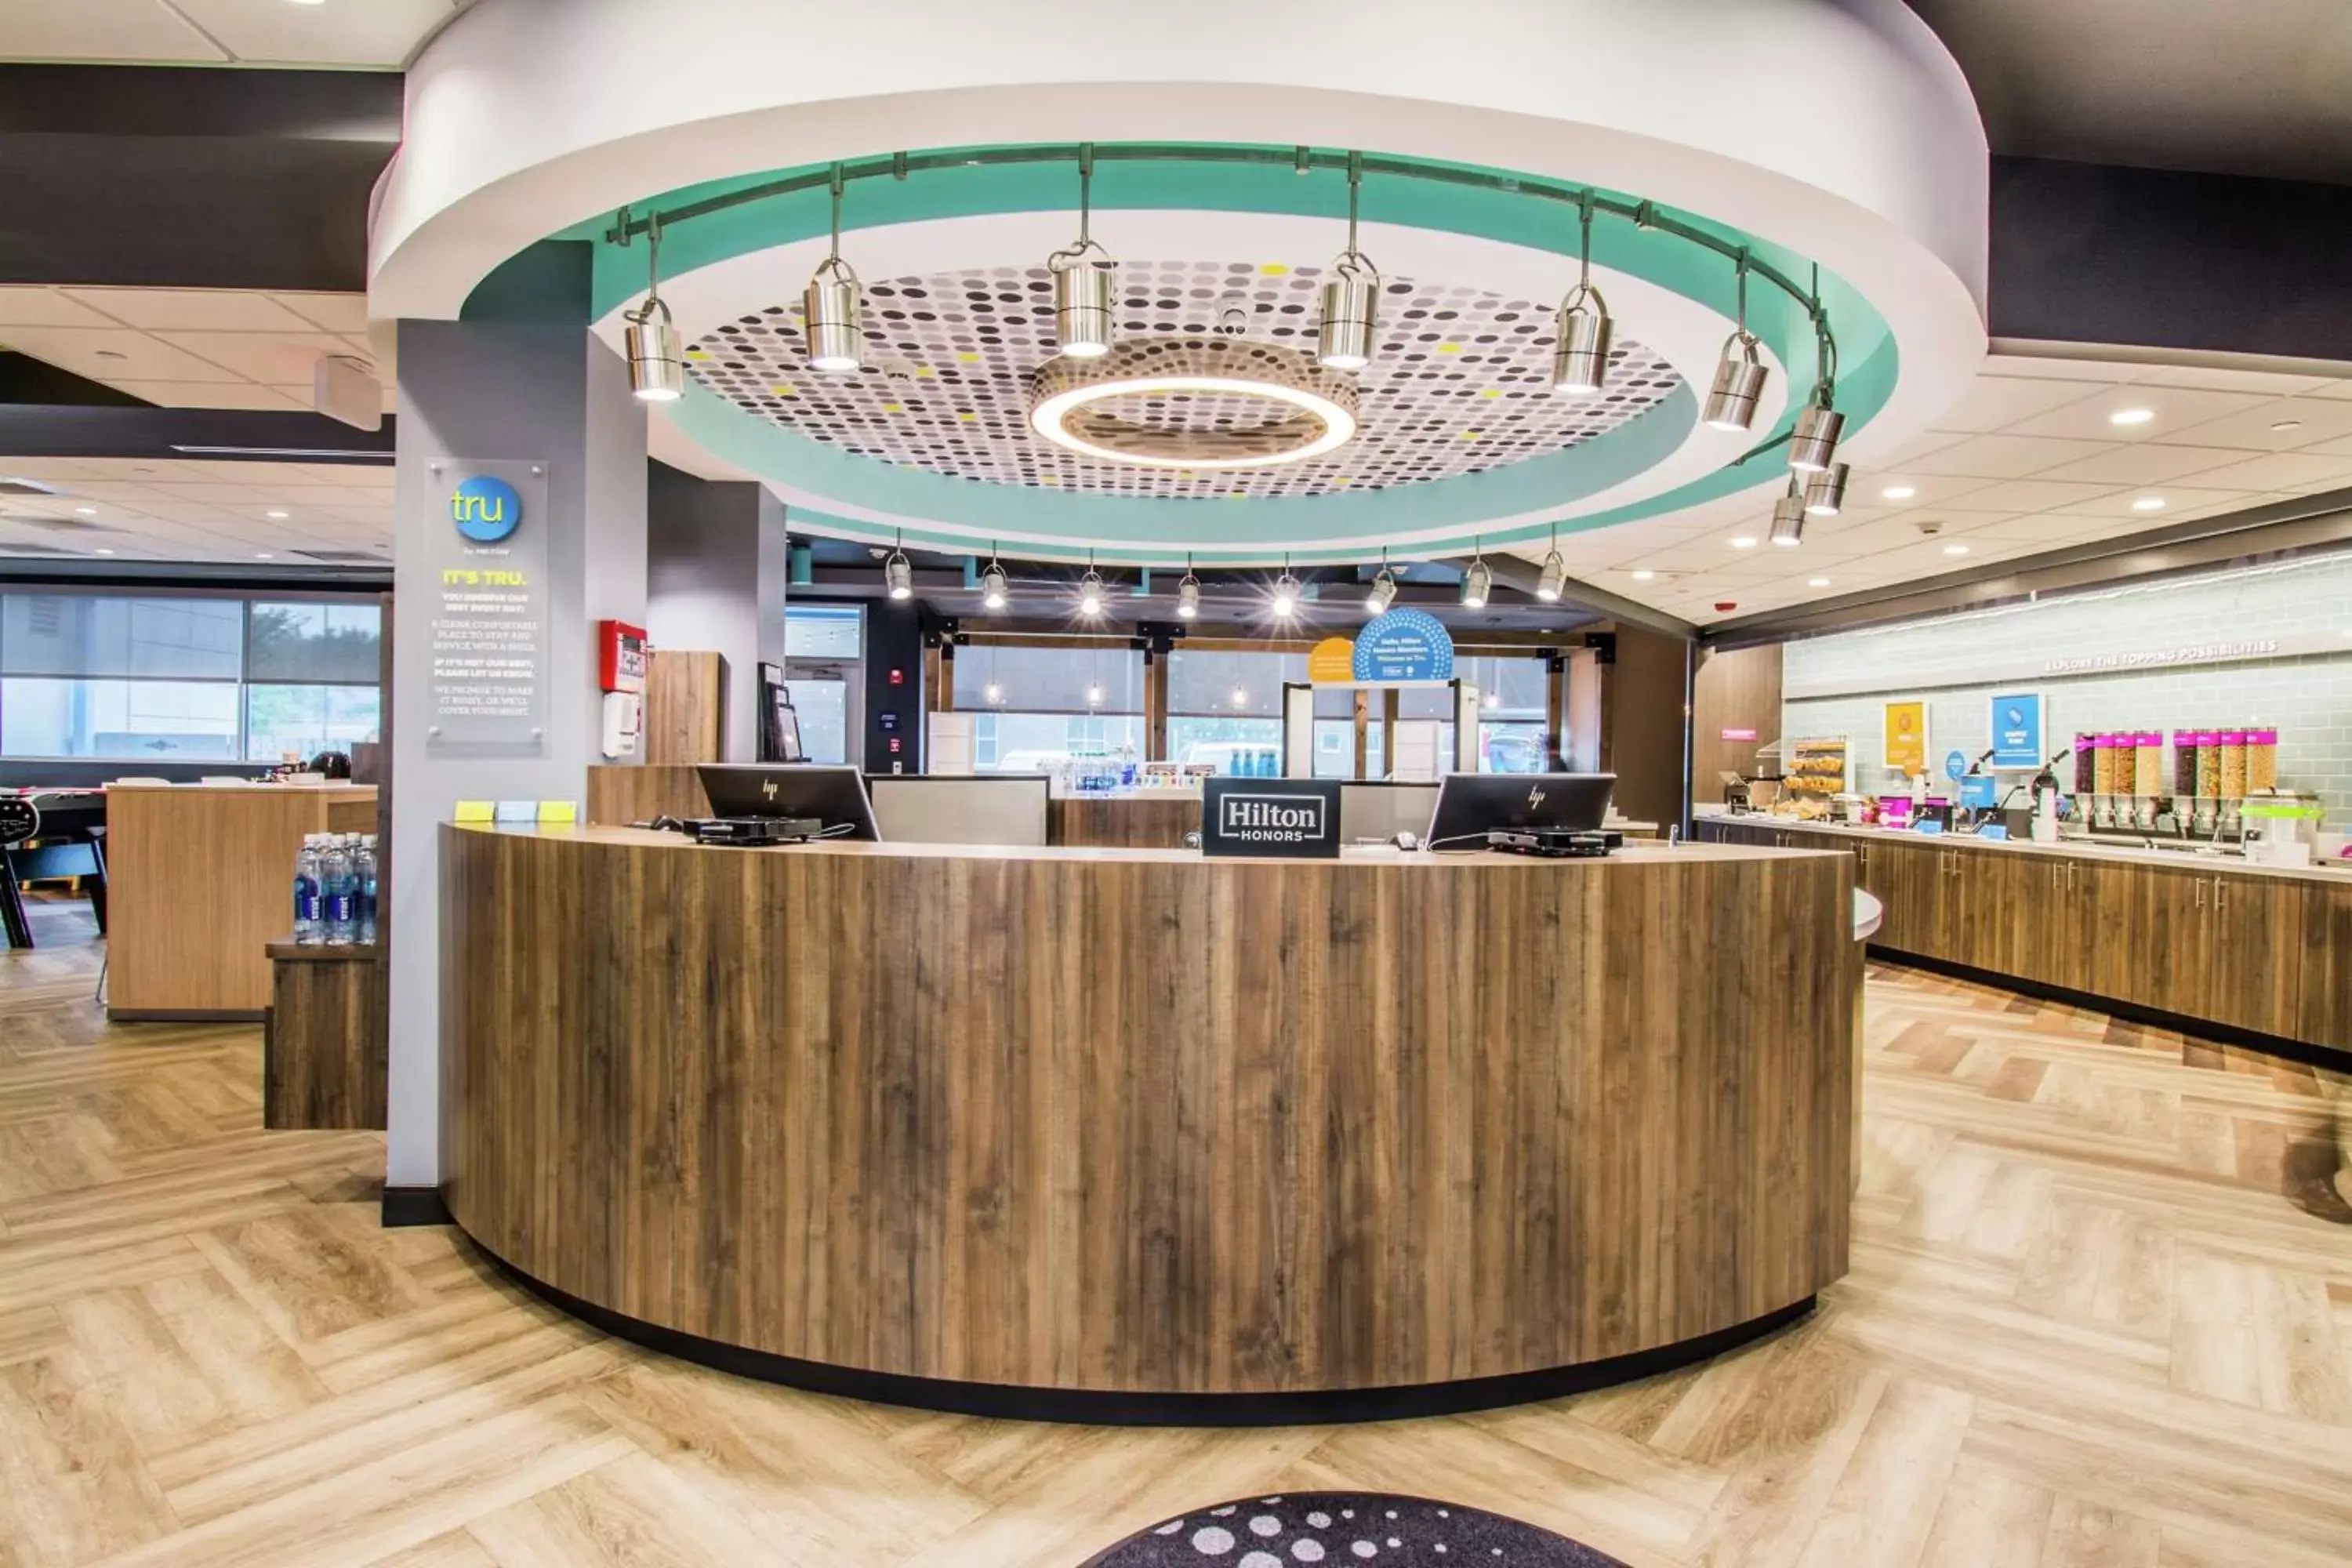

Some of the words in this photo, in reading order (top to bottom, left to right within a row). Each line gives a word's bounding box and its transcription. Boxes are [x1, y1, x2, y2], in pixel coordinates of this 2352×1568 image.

[452, 491, 503, 522] tru
[443, 570, 478, 584] IT'S
[483, 570, 528, 586] TRU.
[2178, 640, 2279, 661] POSSIBILITIES
[763, 779, 779, 800] hp
[1528, 784, 1546, 810] hp
[1228, 801, 1316, 828] Hilton
[1240, 829, 1303, 842] HONORS
